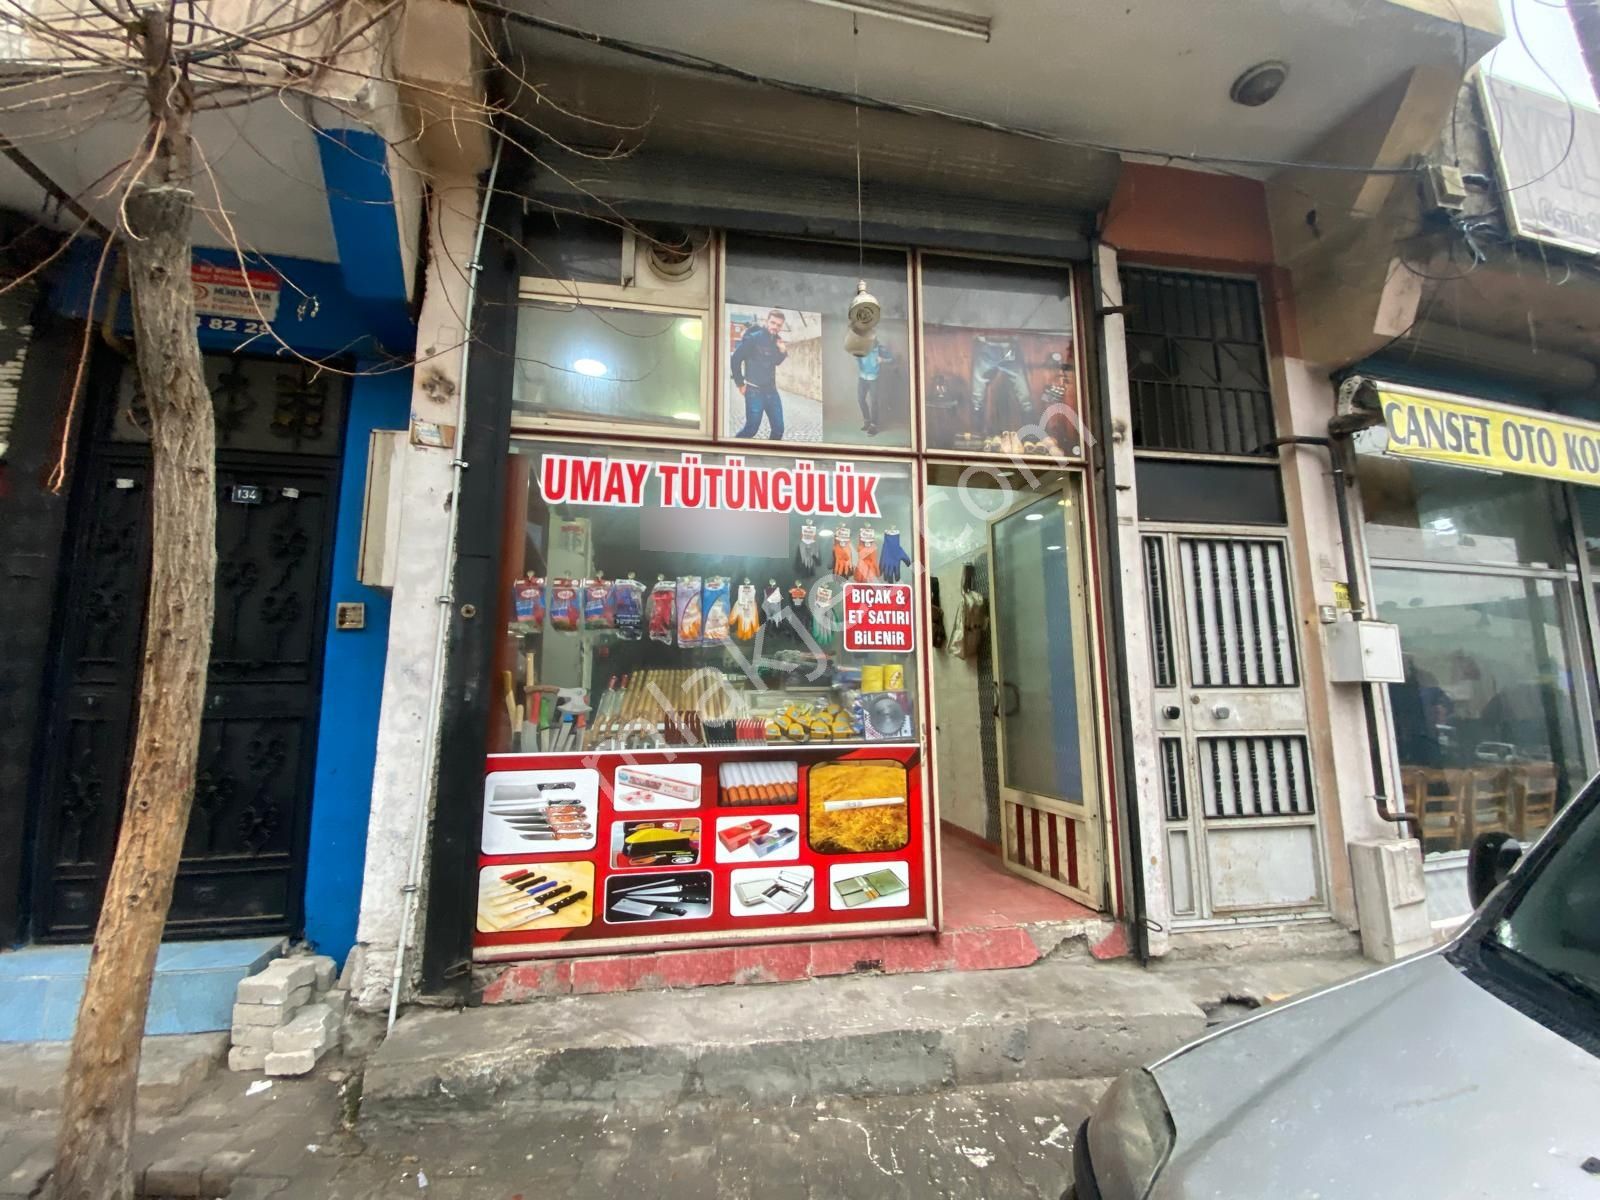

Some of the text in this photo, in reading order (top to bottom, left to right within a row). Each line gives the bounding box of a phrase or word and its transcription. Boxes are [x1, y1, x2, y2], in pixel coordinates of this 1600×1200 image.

[209, 318, 237, 332] 82
[1384, 401, 1600, 474] CANSET OTO KO
[237, 489, 257, 499] 134
[543, 456, 877, 515] UMAY TÜTÜNCÜLÜK
[851, 588, 892, 608] BIÇAK
[895, 589, 906, 605] &
[848, 609, 910, 625] ET SATIRI
